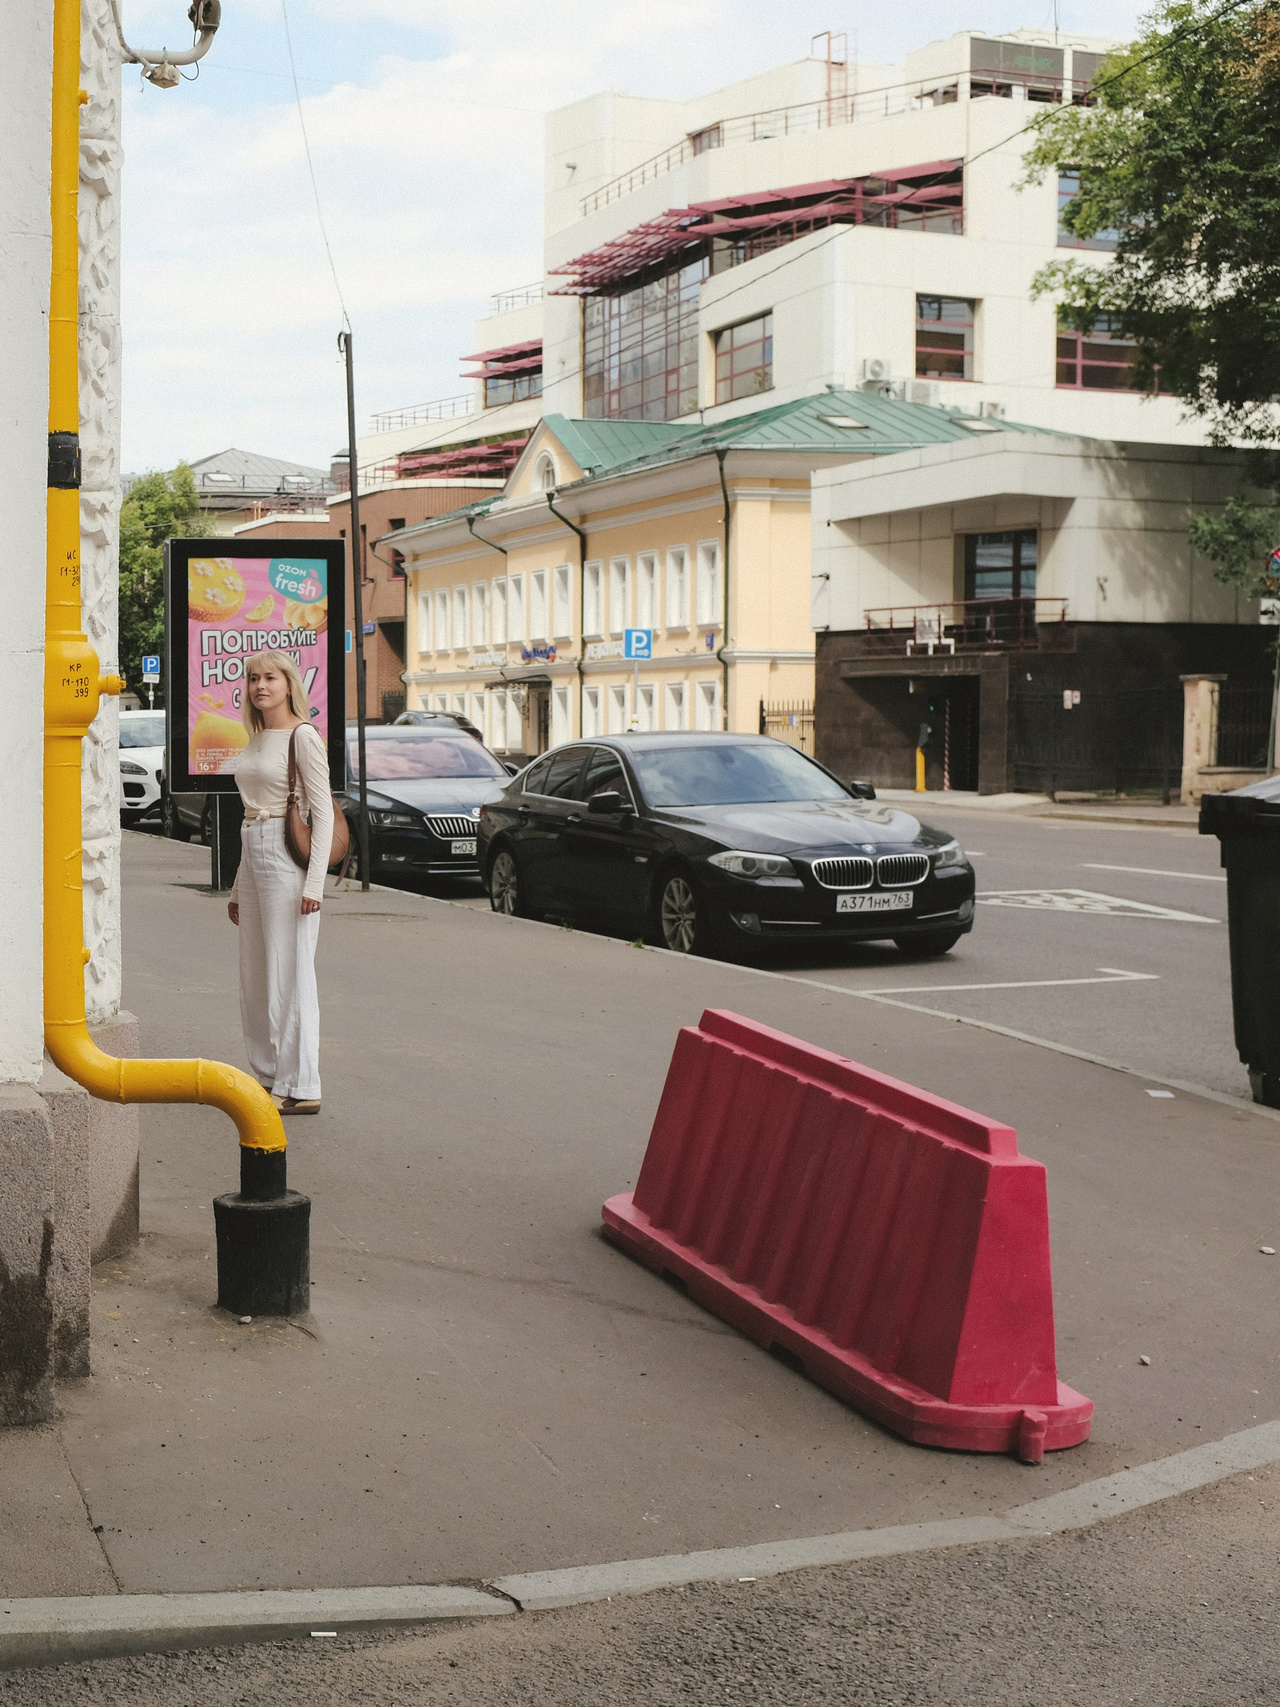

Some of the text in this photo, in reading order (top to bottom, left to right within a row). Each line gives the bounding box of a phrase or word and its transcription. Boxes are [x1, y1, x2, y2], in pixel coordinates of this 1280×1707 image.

[275, 573, 317, 598] fresh
[201, 627, 317, 656] ПОПРОБУЙТЕ
[74, 687, 89, 698] 399
[199, 762, 216, 772] 16+
[840, 896, 890, 910] А371НМ
[892, 893, 910, 903] 763
